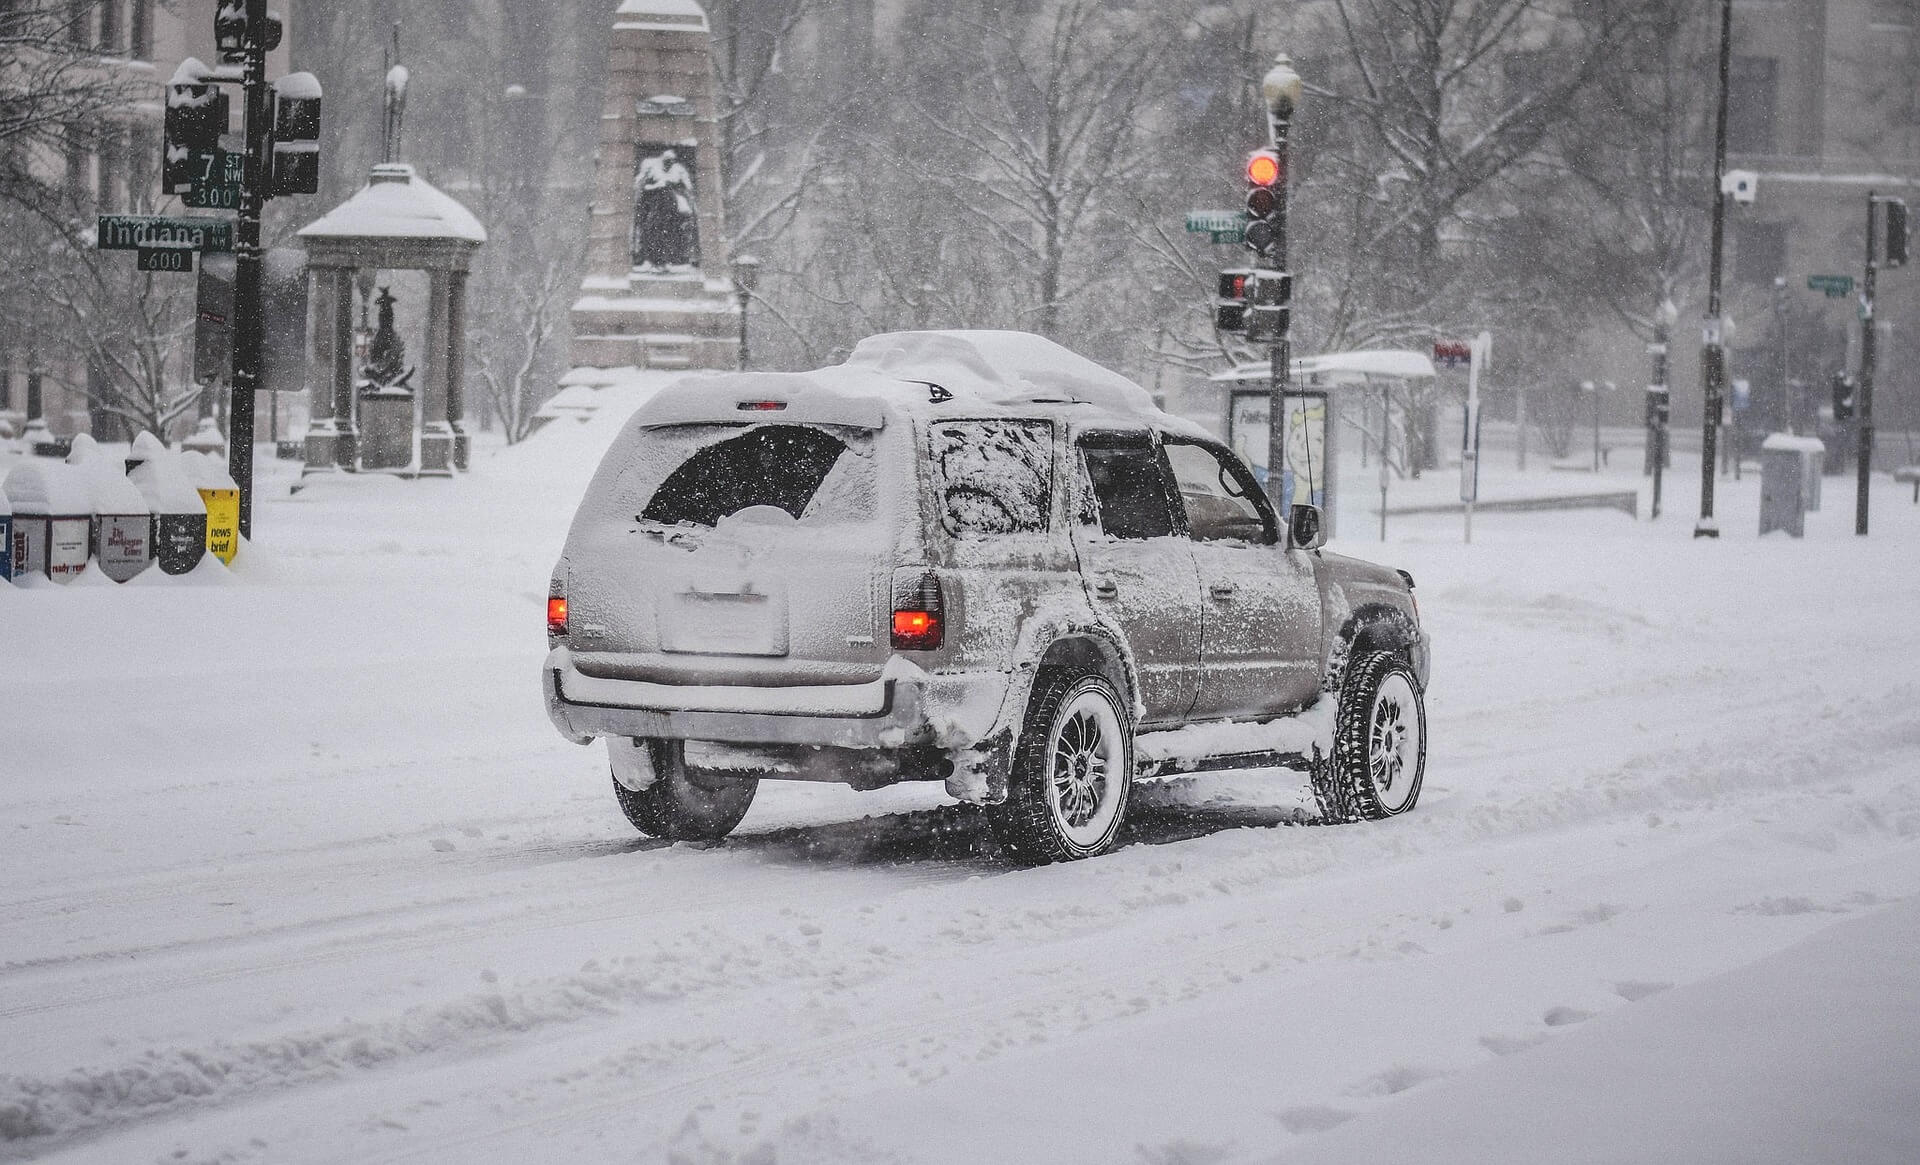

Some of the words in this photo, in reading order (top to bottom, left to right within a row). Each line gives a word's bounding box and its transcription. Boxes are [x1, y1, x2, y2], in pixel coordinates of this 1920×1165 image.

[200, 154, 215, 181] 7
[226, 155, 240, 167] ST
[224, 168, 244, 182] NW
[199, 188, 232, 206] 300
[106, 219, 204, 248] Indiana
[149, 252, 182, 270] 600
[211, 528, 232, 538] news
[210, 540, 230, 553] brief
